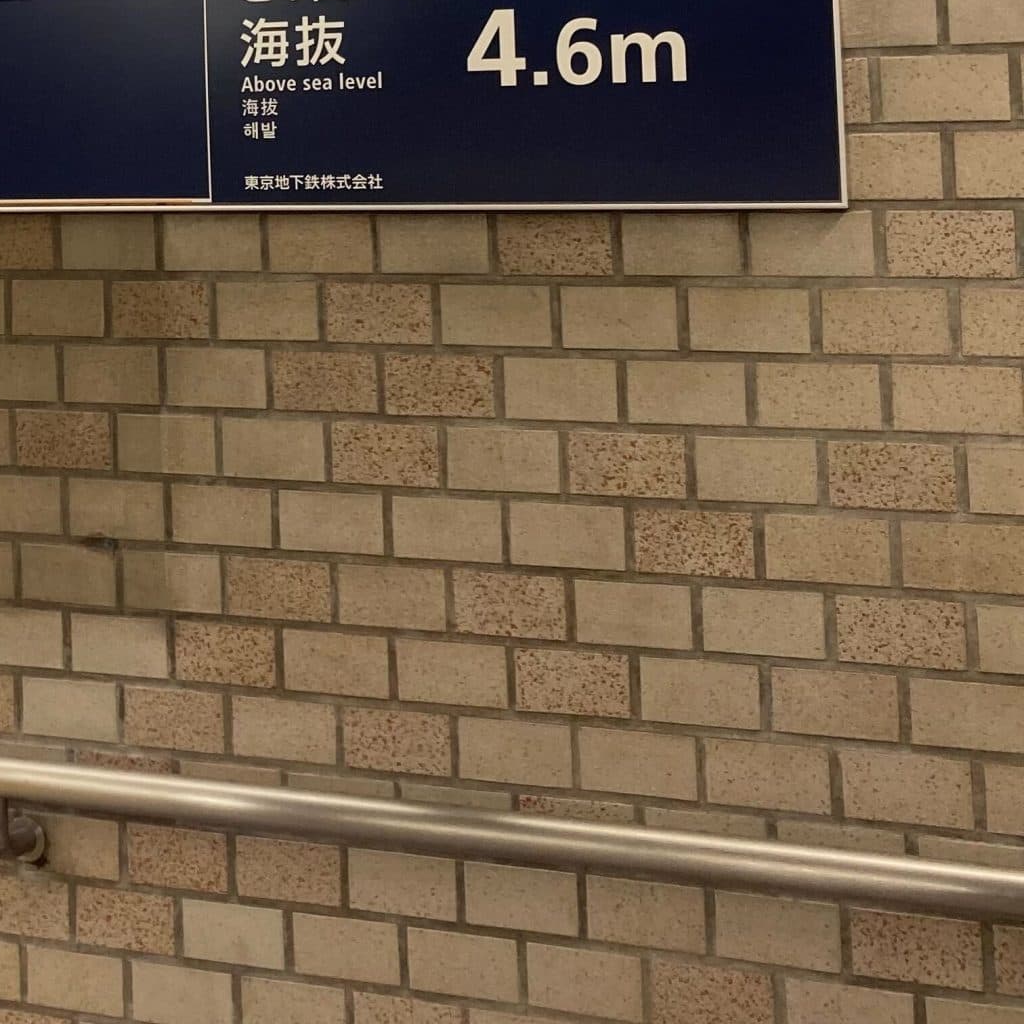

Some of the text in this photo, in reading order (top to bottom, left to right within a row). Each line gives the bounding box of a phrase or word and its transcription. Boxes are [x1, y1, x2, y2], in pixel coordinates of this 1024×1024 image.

[241, 16, 345, 67] 海抜
[467, 9, 687, 86] 4.6m
[241, 73, 382, 92] Above sea level
[243, 121, 277, 139] 해발
[245, 174, 383, 190] 東京地下鉄株式会社
